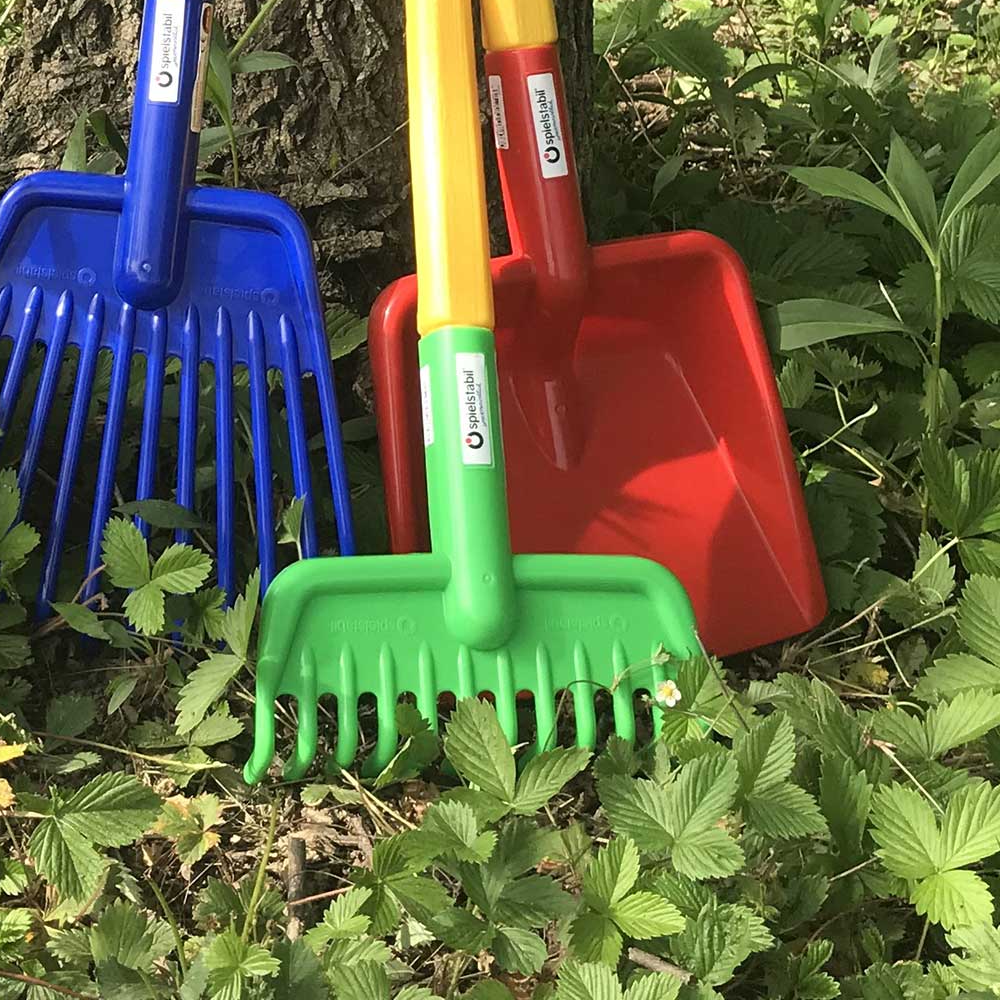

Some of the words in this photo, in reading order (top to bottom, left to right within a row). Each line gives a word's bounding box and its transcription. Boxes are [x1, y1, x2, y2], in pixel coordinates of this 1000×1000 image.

[161, 13, 173, 69] spielstabil
[535, 89, 555, 145] spielstabil
[463, 370, 480, 429] spielstabil
